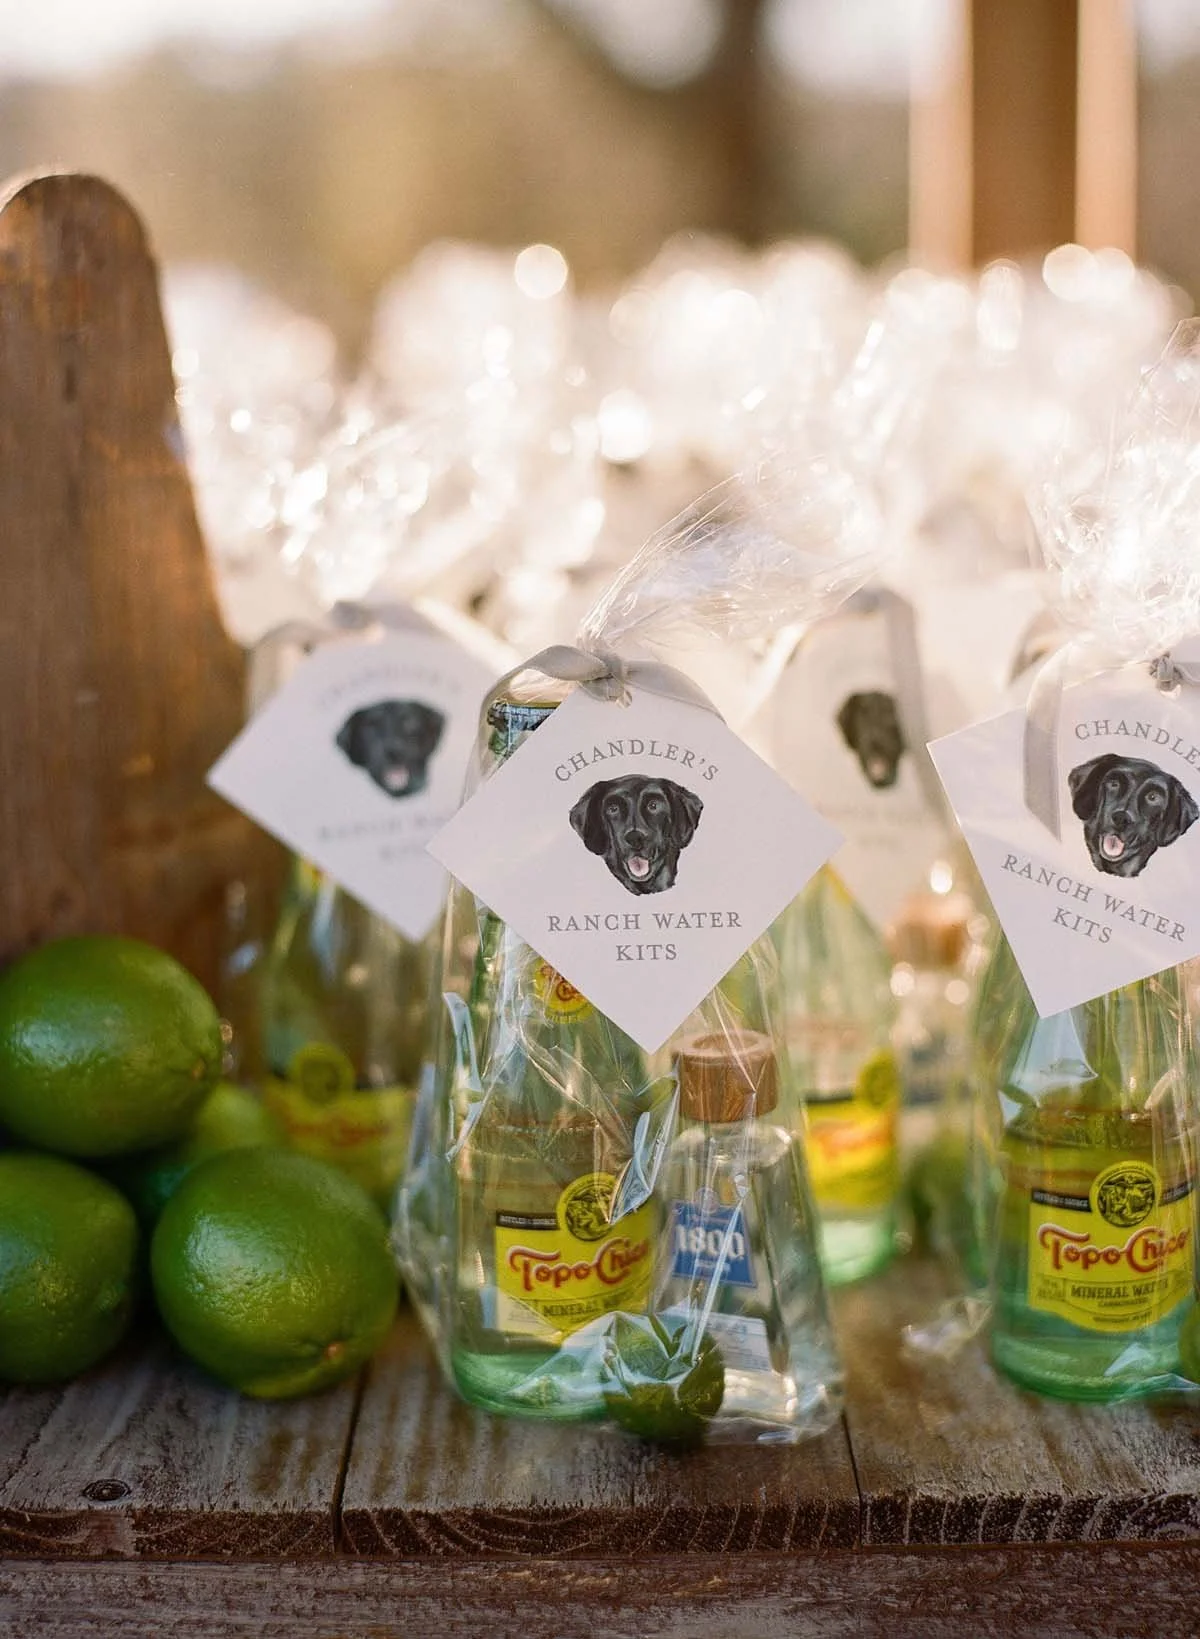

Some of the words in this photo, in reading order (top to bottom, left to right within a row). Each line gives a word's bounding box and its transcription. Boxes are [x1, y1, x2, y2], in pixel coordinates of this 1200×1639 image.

[554, 739, 719, 782] CHANDLER'S
[1075, 719, 1200, 773] CHANDLE
[1001, 854, 1095, 903] RANCH
[1103, 894, 1187, 942] WATER
[547, 912, 641, 933] RANCH
[652, 911, 743, 930] WATER
[1052, 907, 1114, 944] KITS
[615, 943, 678, 962] KITS
[676, 1224, 745, 1261] 1800
[1037, 1223, 1122, 1271] Topo
[507, 1245, 592, 1292] Topo
[1070, 1284, 1130, 1299] MINERAL
[1132, 1279, 1169, 1297] WATR
